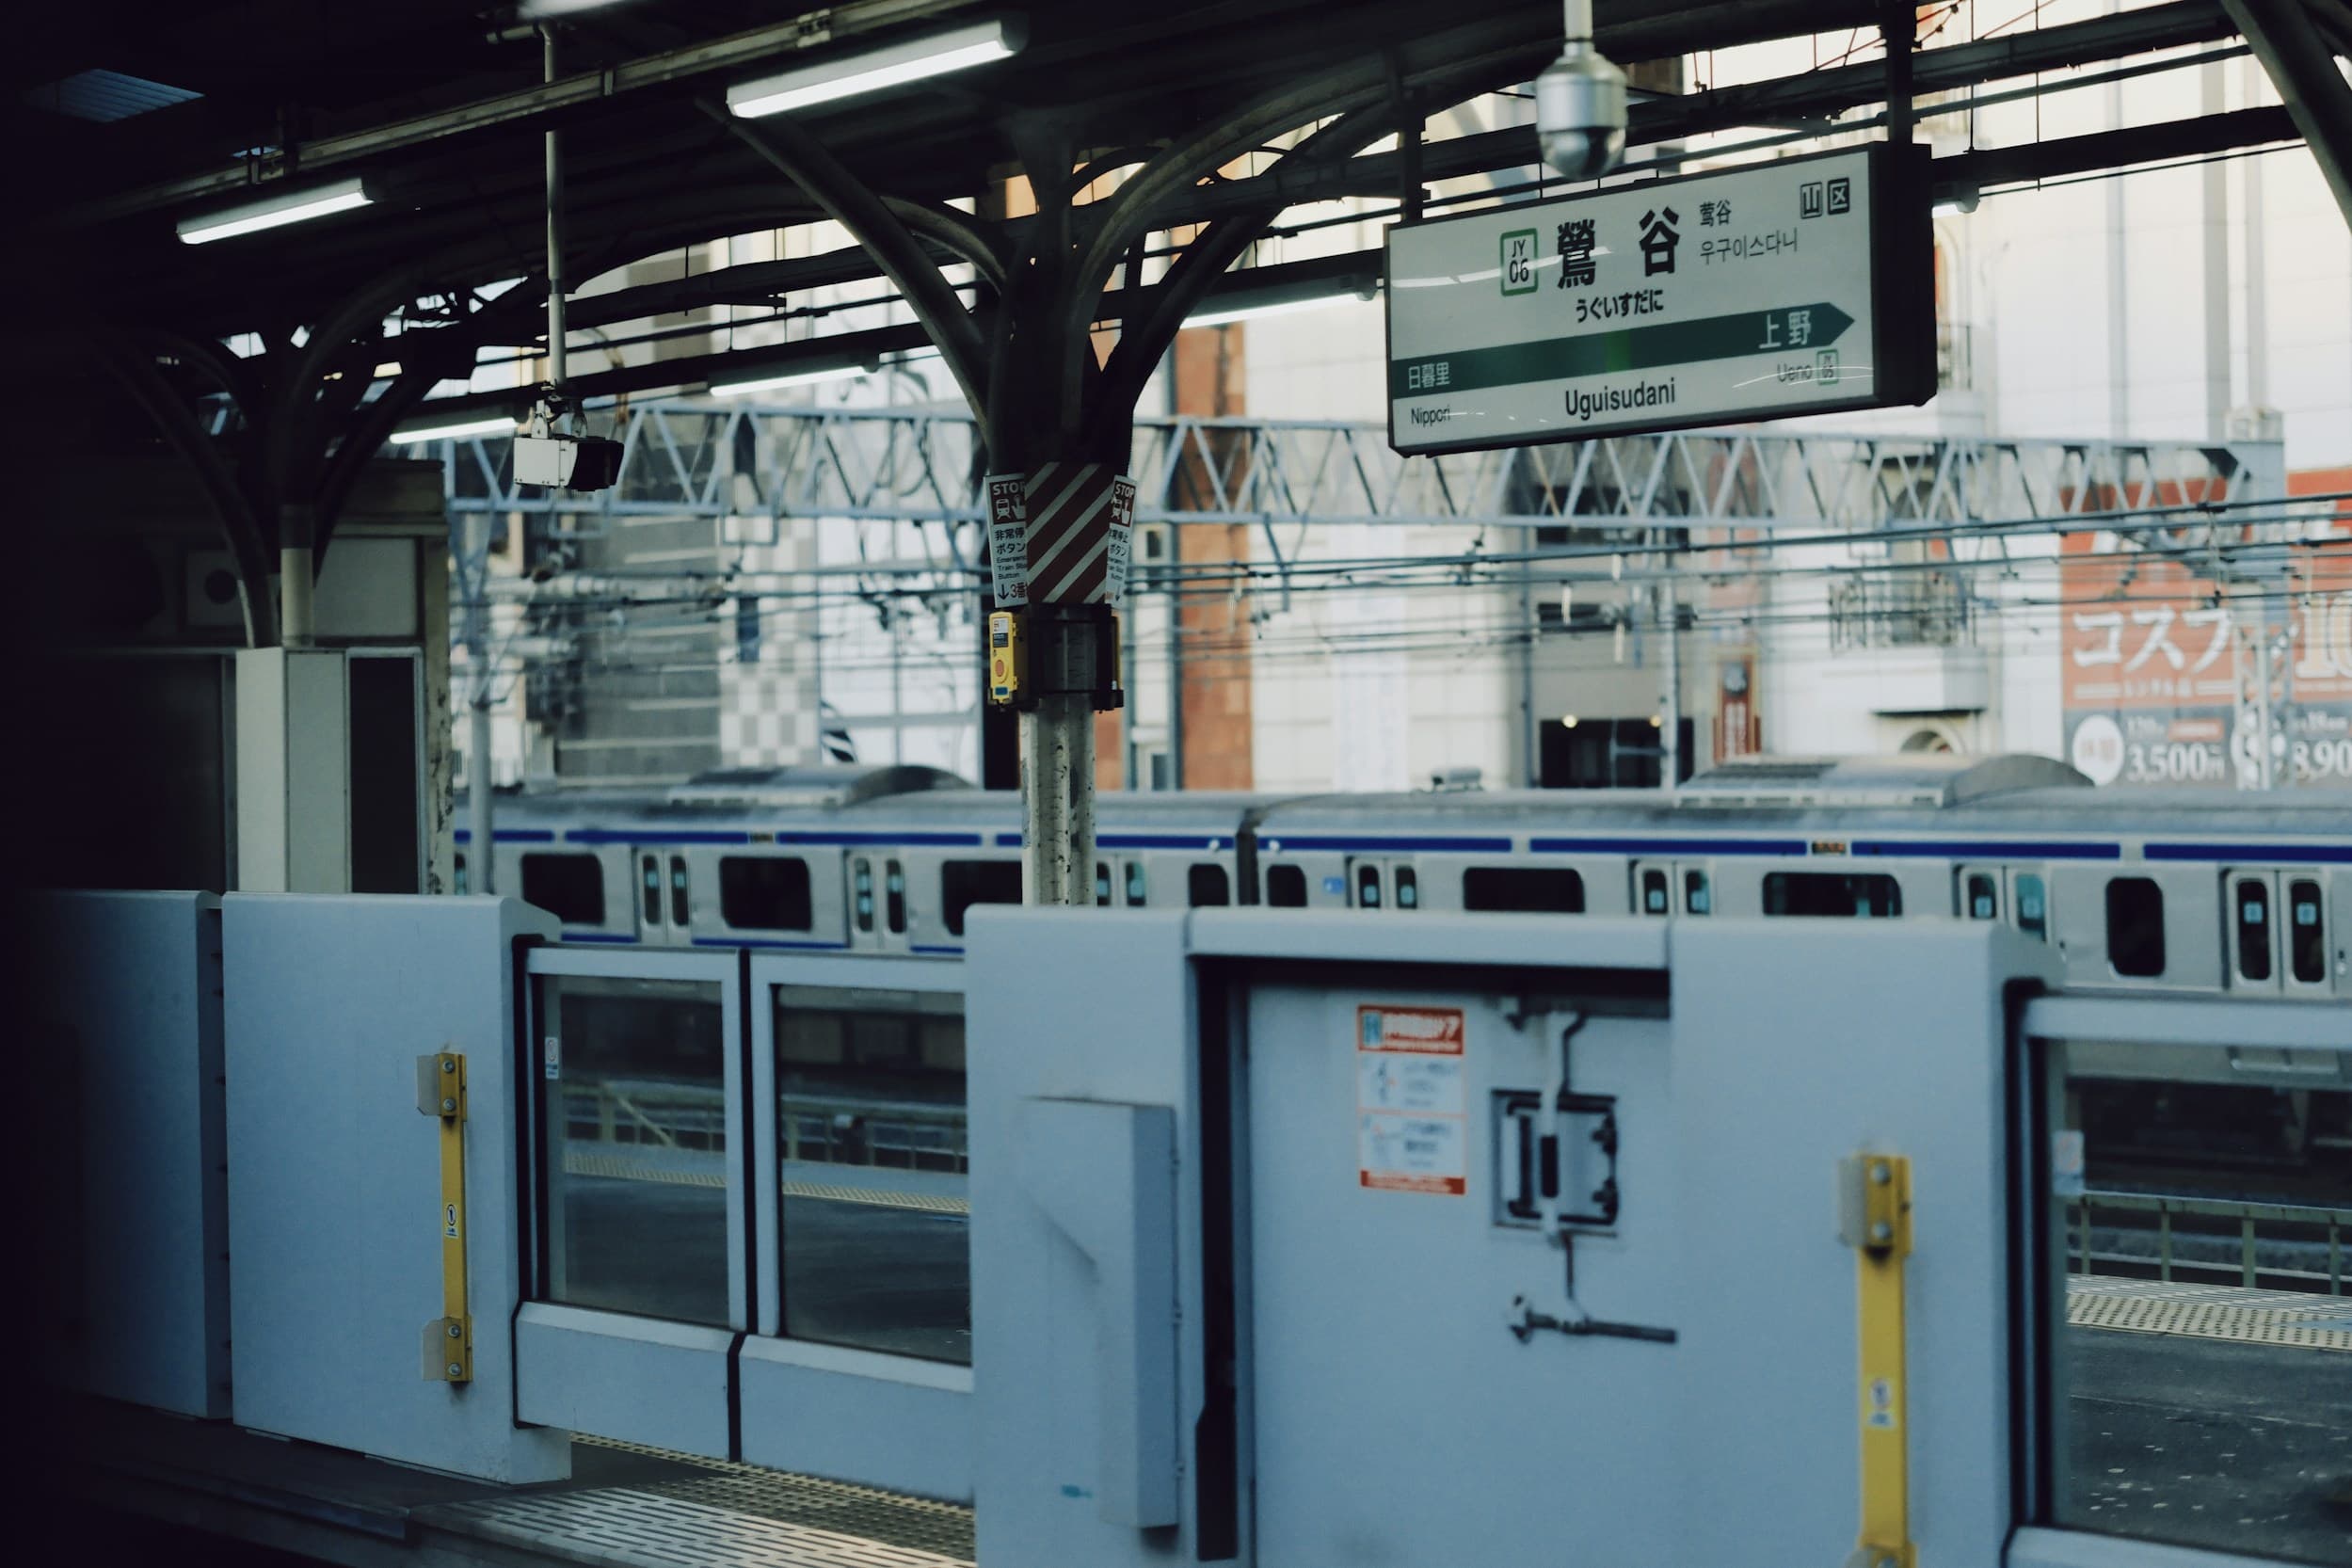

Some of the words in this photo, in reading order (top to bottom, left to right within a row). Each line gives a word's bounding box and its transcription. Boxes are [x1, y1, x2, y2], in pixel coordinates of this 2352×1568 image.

[1829, 180, 1848, 213] 区
[1512, 238, 1527, 257] JY
[1700, 227, 1798, 265] 우구이스다니
[1509, 258, 1529, 283] 06
[1576, 289, 1664, 323] うぐいすだに
[1758, 310, 1812, 349] 上野
[1408, 361, 1451, 390] 日暮里
[1776, 362, 1813, 382] Ueno
[1565, 376, 1675, 421] Uguisudani
[1411, 404, 1451, 427] Nippori
[1115, 483, 1135, 498] STOP
[1010, 582, 1027, 599] 3番
